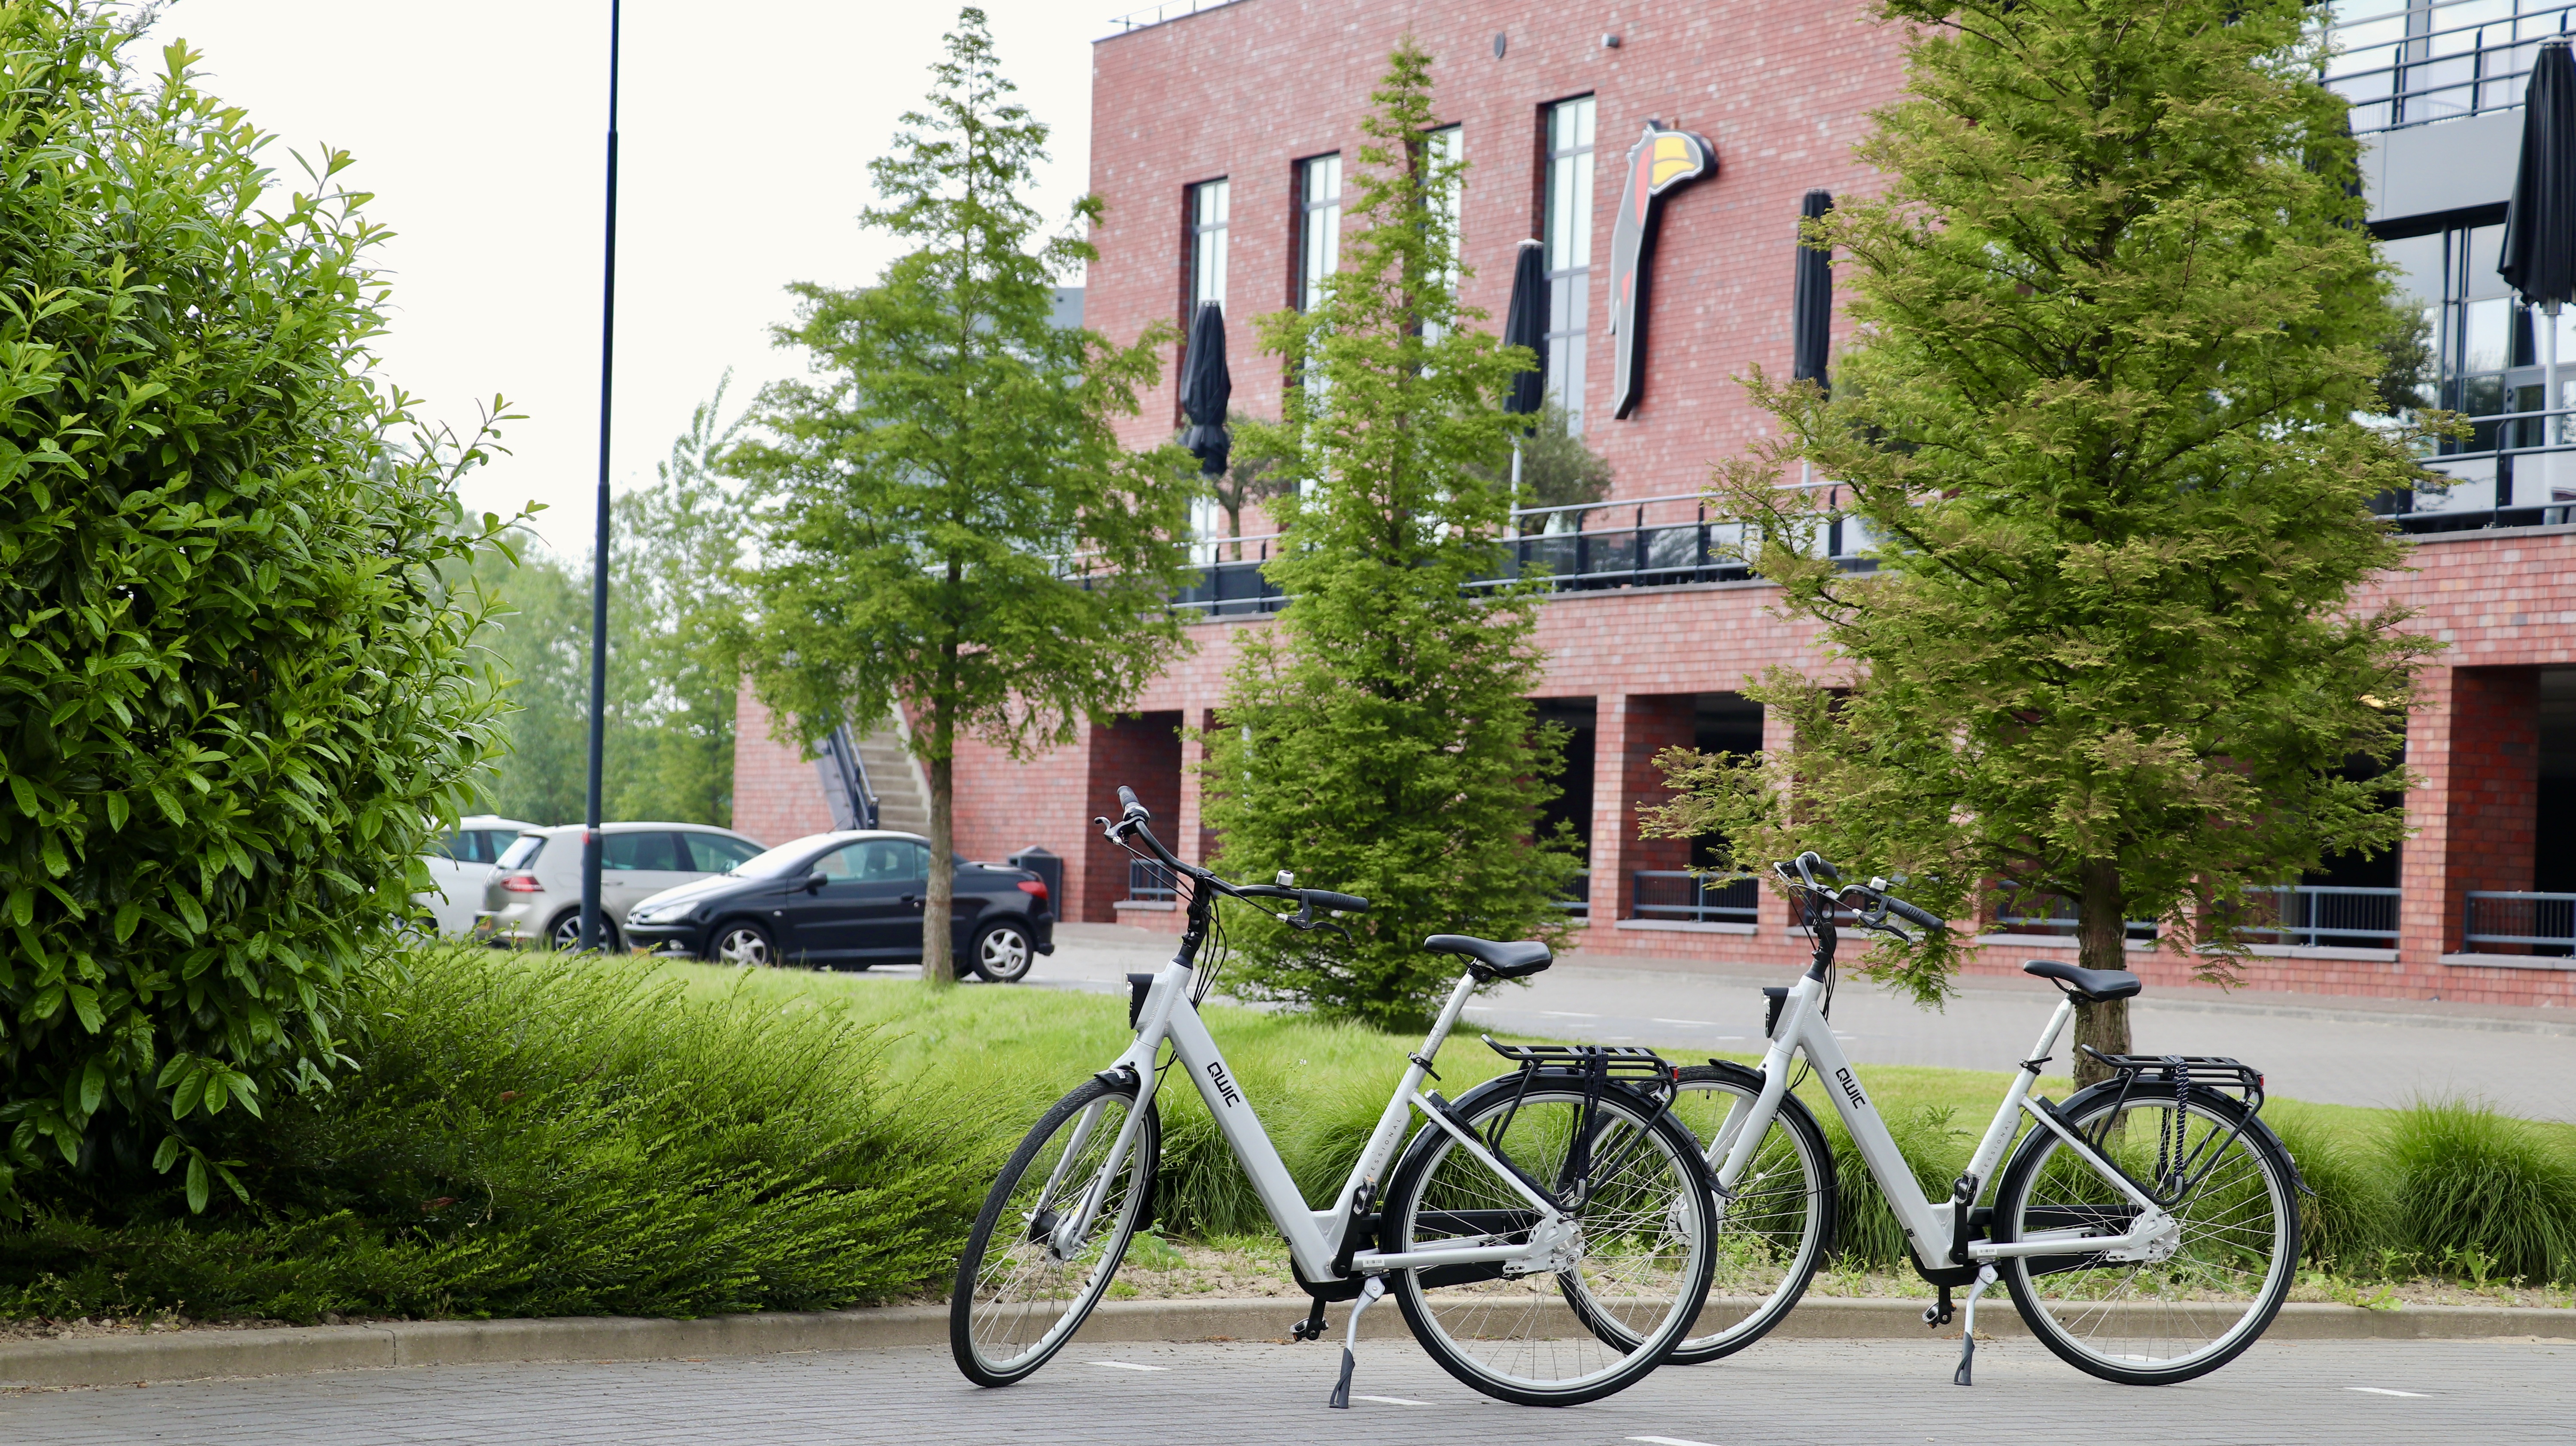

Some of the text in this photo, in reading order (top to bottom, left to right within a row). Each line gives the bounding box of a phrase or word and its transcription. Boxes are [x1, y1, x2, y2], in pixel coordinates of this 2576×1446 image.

[1207, 1062, 1240, 1108] QWIC
[1835, 1068, 1866, 1109] QWIC
[1367, 1119, 1402, 1177] FESSIONAL
[1978, 1120, 2013, 1180] OFESSIONAL
